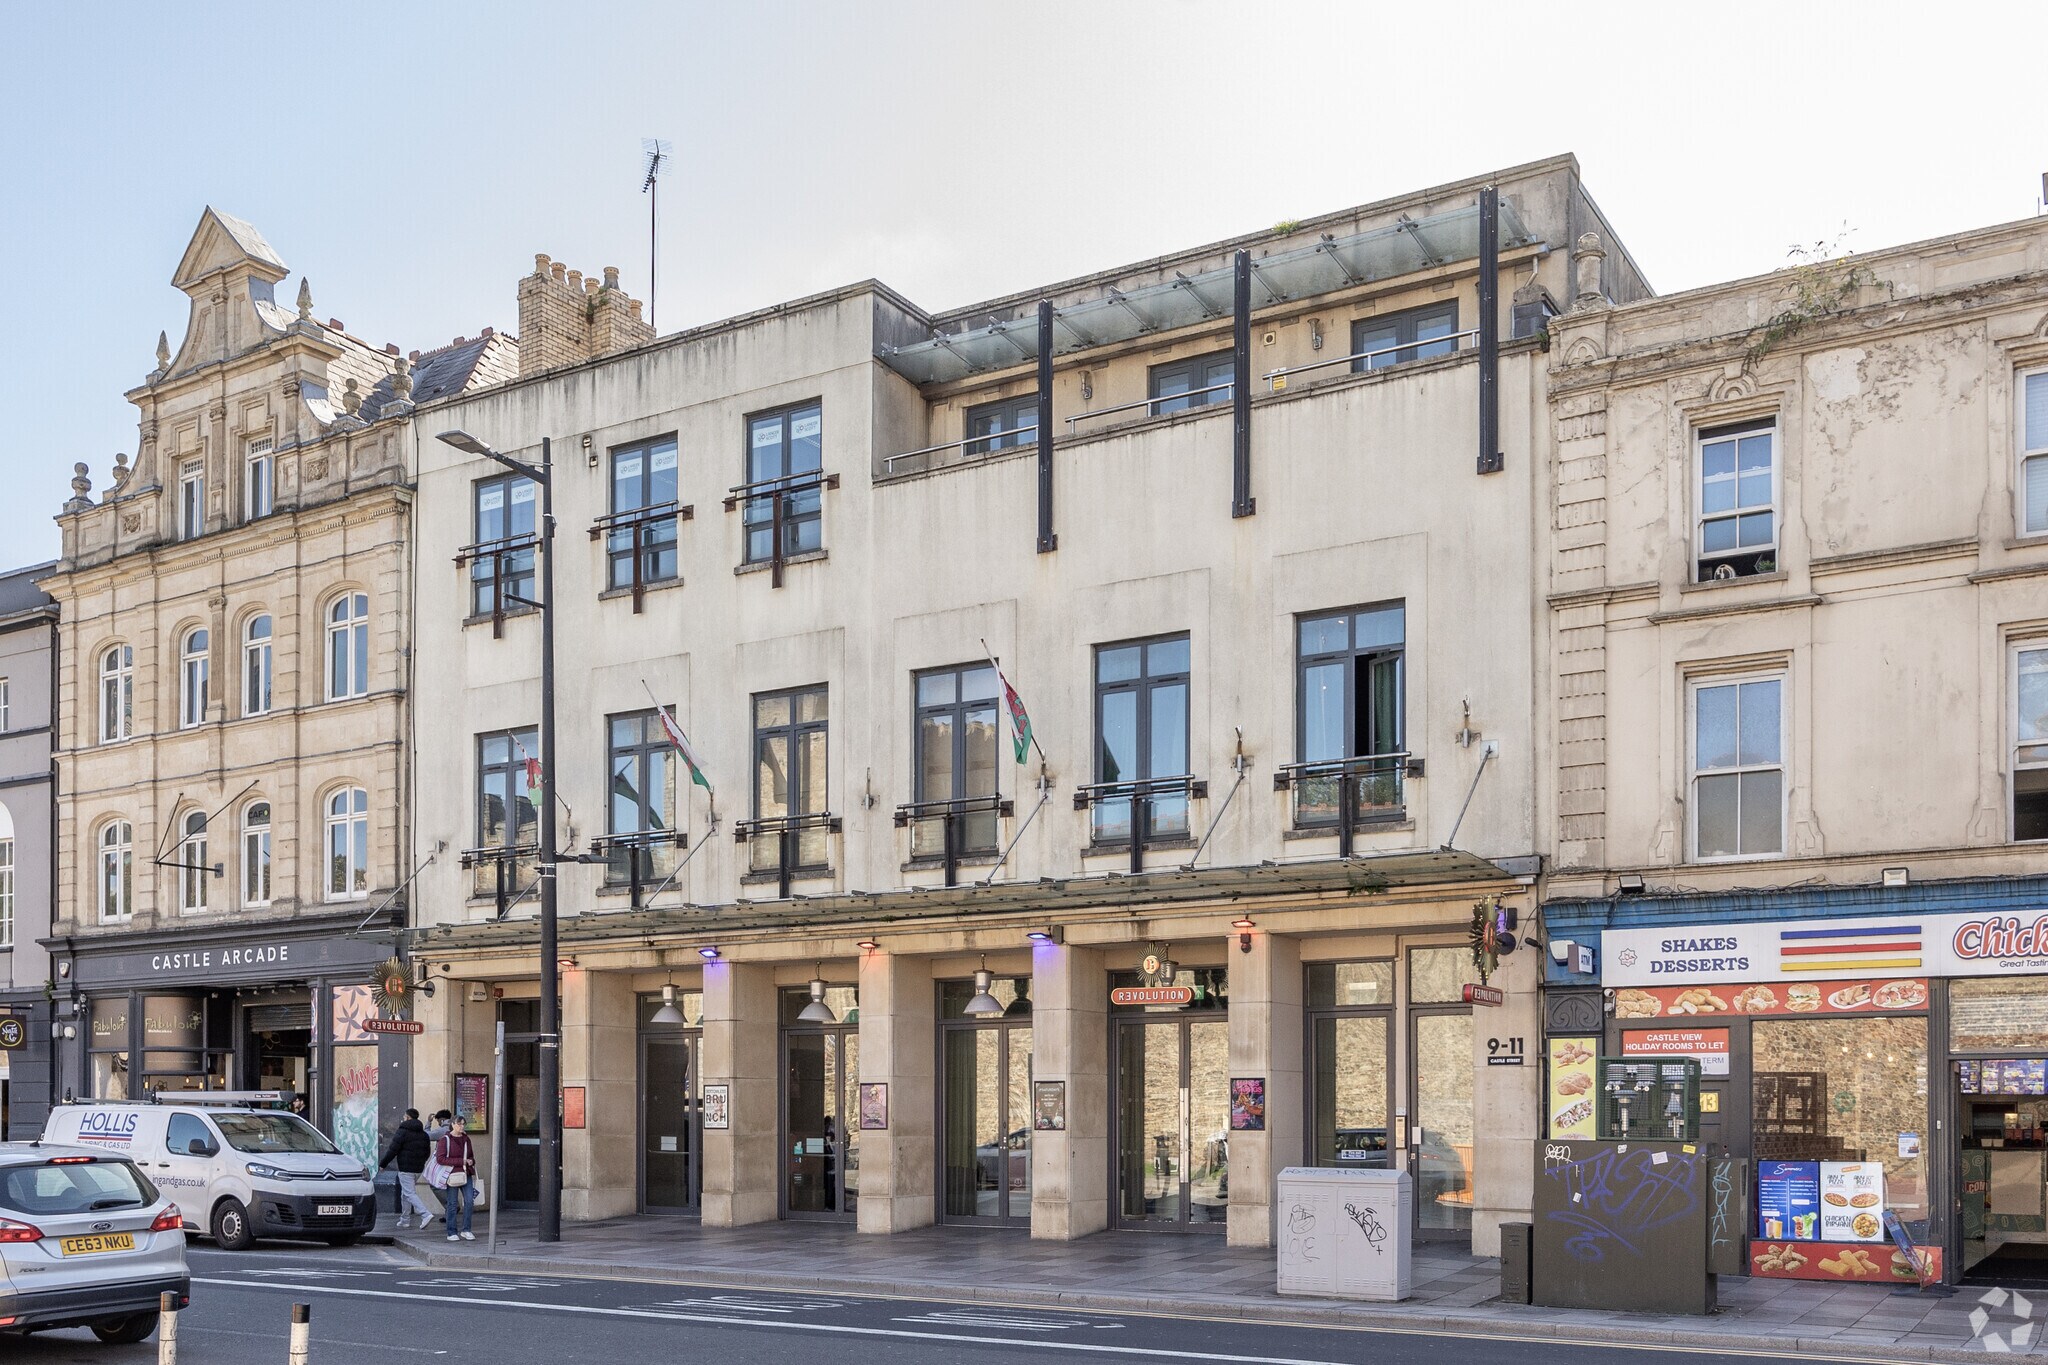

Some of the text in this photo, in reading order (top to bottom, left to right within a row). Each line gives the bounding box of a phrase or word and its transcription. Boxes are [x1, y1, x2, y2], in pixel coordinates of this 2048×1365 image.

[1661, 937, 1738, 953] SHAKES
[152, 945, 288, 970] CASTLE ARCADE
[1650, 957, 1750, 973] DESSERTS
[1999, 960, 2025, 968] Great
[1118, 990, 1184, 1001] REVOLUTION
[371, 1021, 420, 1032] REVOLUTION
[1681, 1033, 1702, 1041] VIEW
[1487, 1037, 1523, 1054] 9-11
[1625, 1041, 1724, 1051] HOLIDAY ROOMS TO LET
[1702, 1056, 1724, 1064] TERM
[1701, 1094, 1716, 1111] 13
[80, 1112, 138, 1132] HOLLIS
[66, 1235, 131, 1252] CE63 NKU
